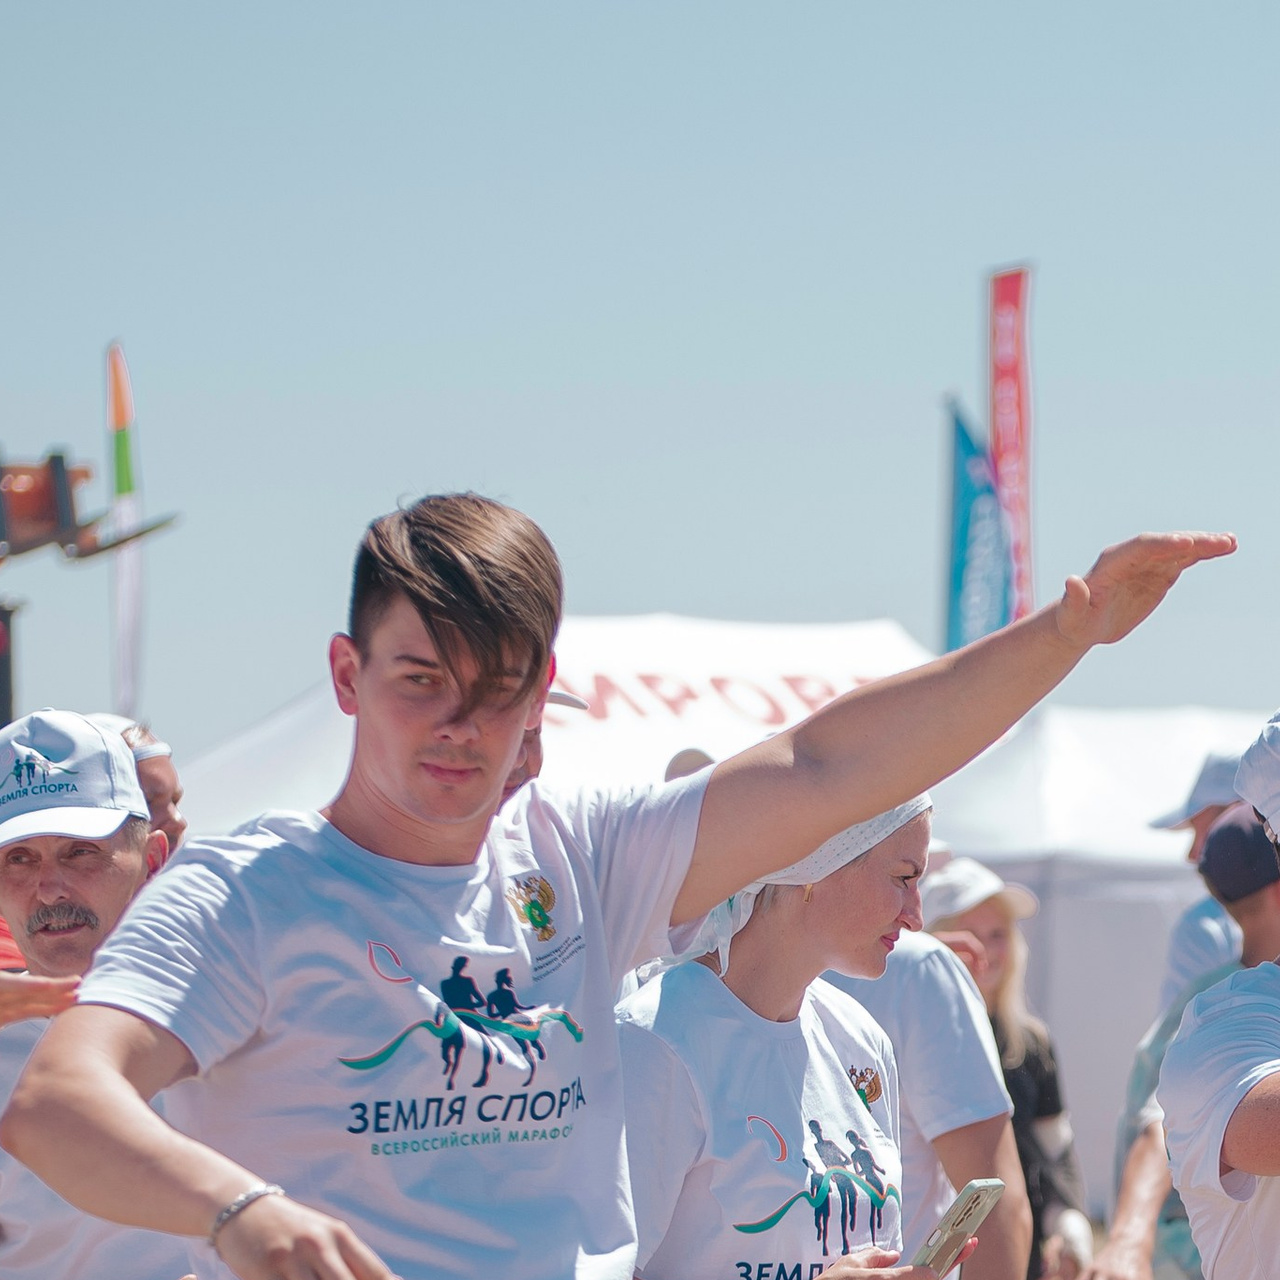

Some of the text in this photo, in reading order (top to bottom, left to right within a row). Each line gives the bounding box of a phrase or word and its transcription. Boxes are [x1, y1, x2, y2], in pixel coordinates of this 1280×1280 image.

[31, 783, 79, 795] СПОРТА
[347, 1076, 587, 1134] ЗЕМЛЯ СПОРТА
[371, 1122, 574, 1156] ВСЕРОССИЙСКИЙ МАРАФО
